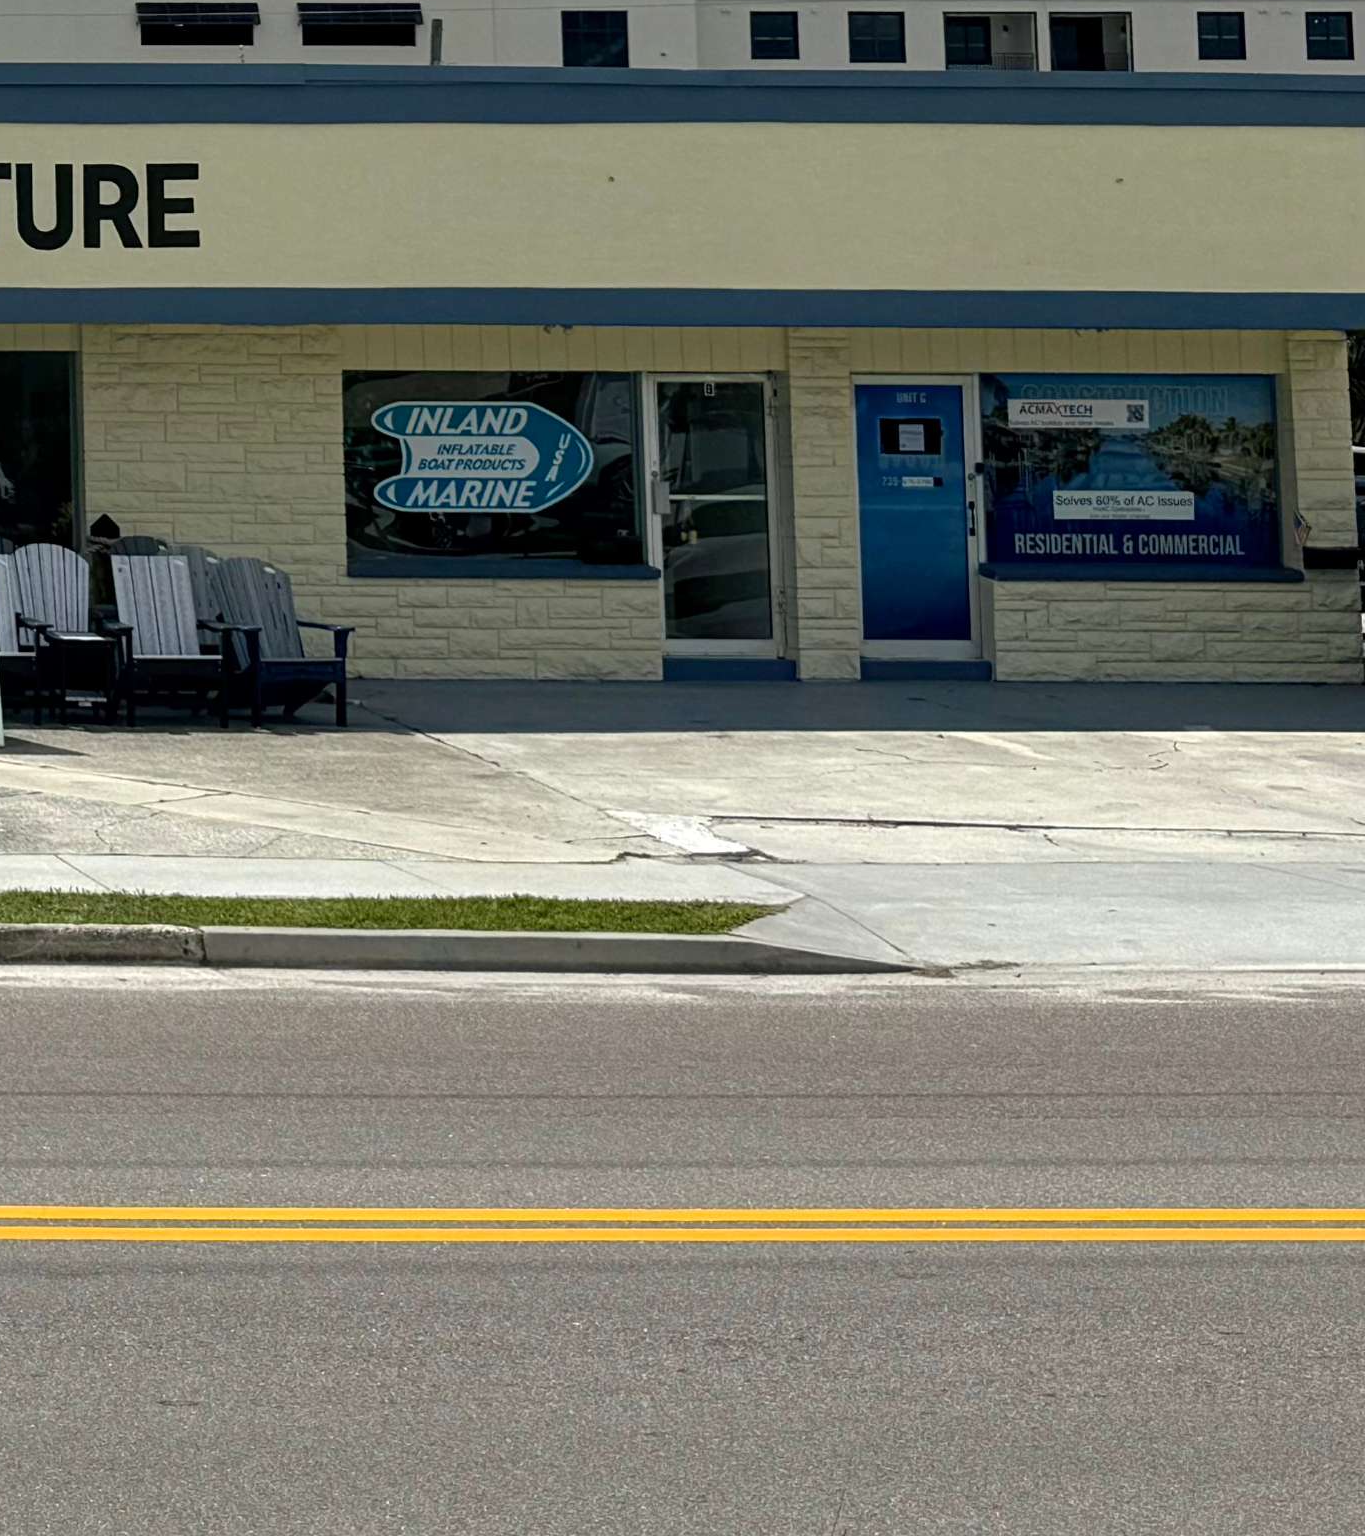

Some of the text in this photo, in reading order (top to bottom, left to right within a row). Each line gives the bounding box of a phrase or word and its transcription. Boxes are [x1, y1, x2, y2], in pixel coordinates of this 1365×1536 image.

[896, 391, 918, 404] UNIT
[1019, 402, 1094, 417] ACMAXTECH
[406, 407, 529, 435] INLAND
[437, 443, 516, 456] INFLATABLE
[417, 458, 527, 471] BOAT PRODUCTS
[544, 433, 572, 483] USA
[405, 480, 537, 509] MARINE
[1055, 495, 1193, 506] Solves 80% of AC Issues
[1014, 532, 1246, 556] RESIDENTIAL & COMMERCIAL
